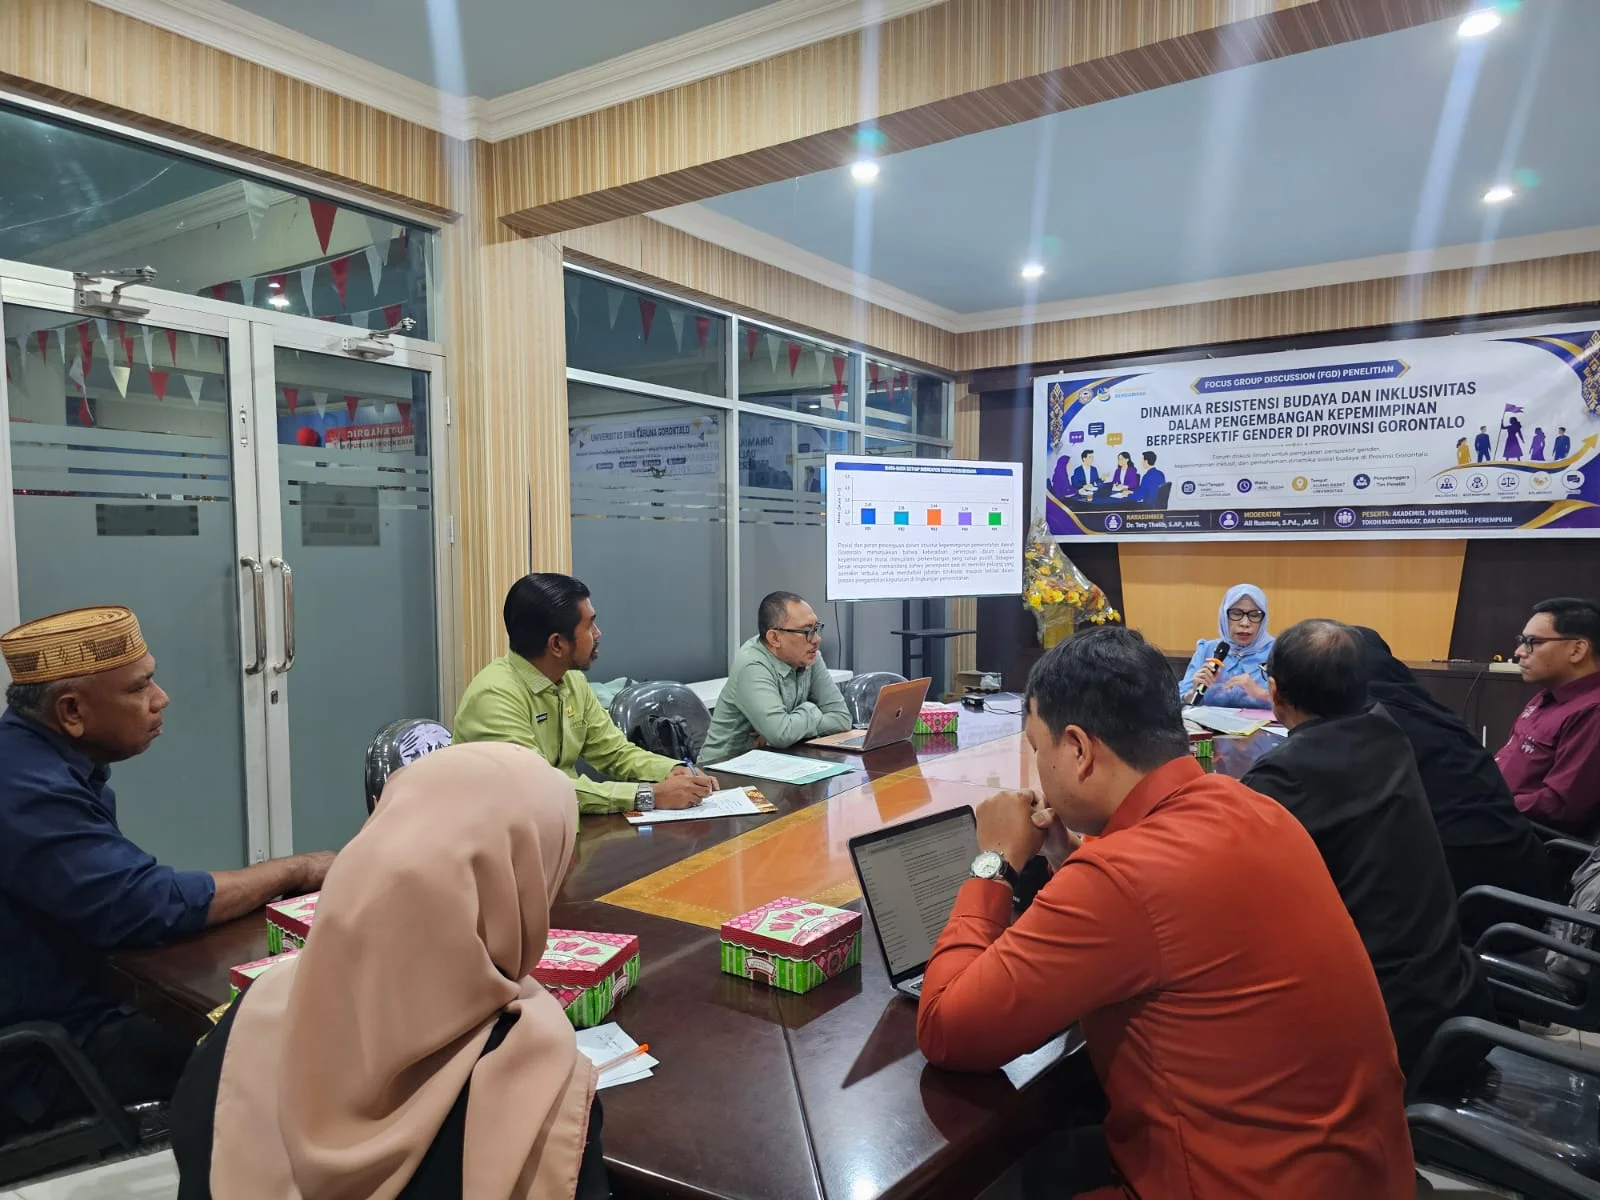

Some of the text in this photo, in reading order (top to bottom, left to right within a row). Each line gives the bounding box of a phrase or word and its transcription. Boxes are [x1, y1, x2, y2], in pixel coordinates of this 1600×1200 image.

[1205, 365, 1394, 389] FOCUS GROUP DISCUSSION (FGD) PENELITIAN
[1140, 381, 1477, 419] DINAMIKA RESISTENSI BUDAYA DAN INKLUSIVITAS
[1168, 401, 1437, 431] DALAM PENGEMBANGAN KEPEMIMPINAN
[1146, 415, 1465, 447] BERPERSPEKTIF GENDER DI PROVINSI GORONTALO
[1362, 518, 1381, 526] TOKOH
[1382, 518, 1422, 526] MASYARAKAT,
[1436, 517, 1474, 525] ORGANISASI
[1475, 516, 1513, 524] PEREMPUAN
[1427, 509, 1468, 517] PEMERINTAH,
